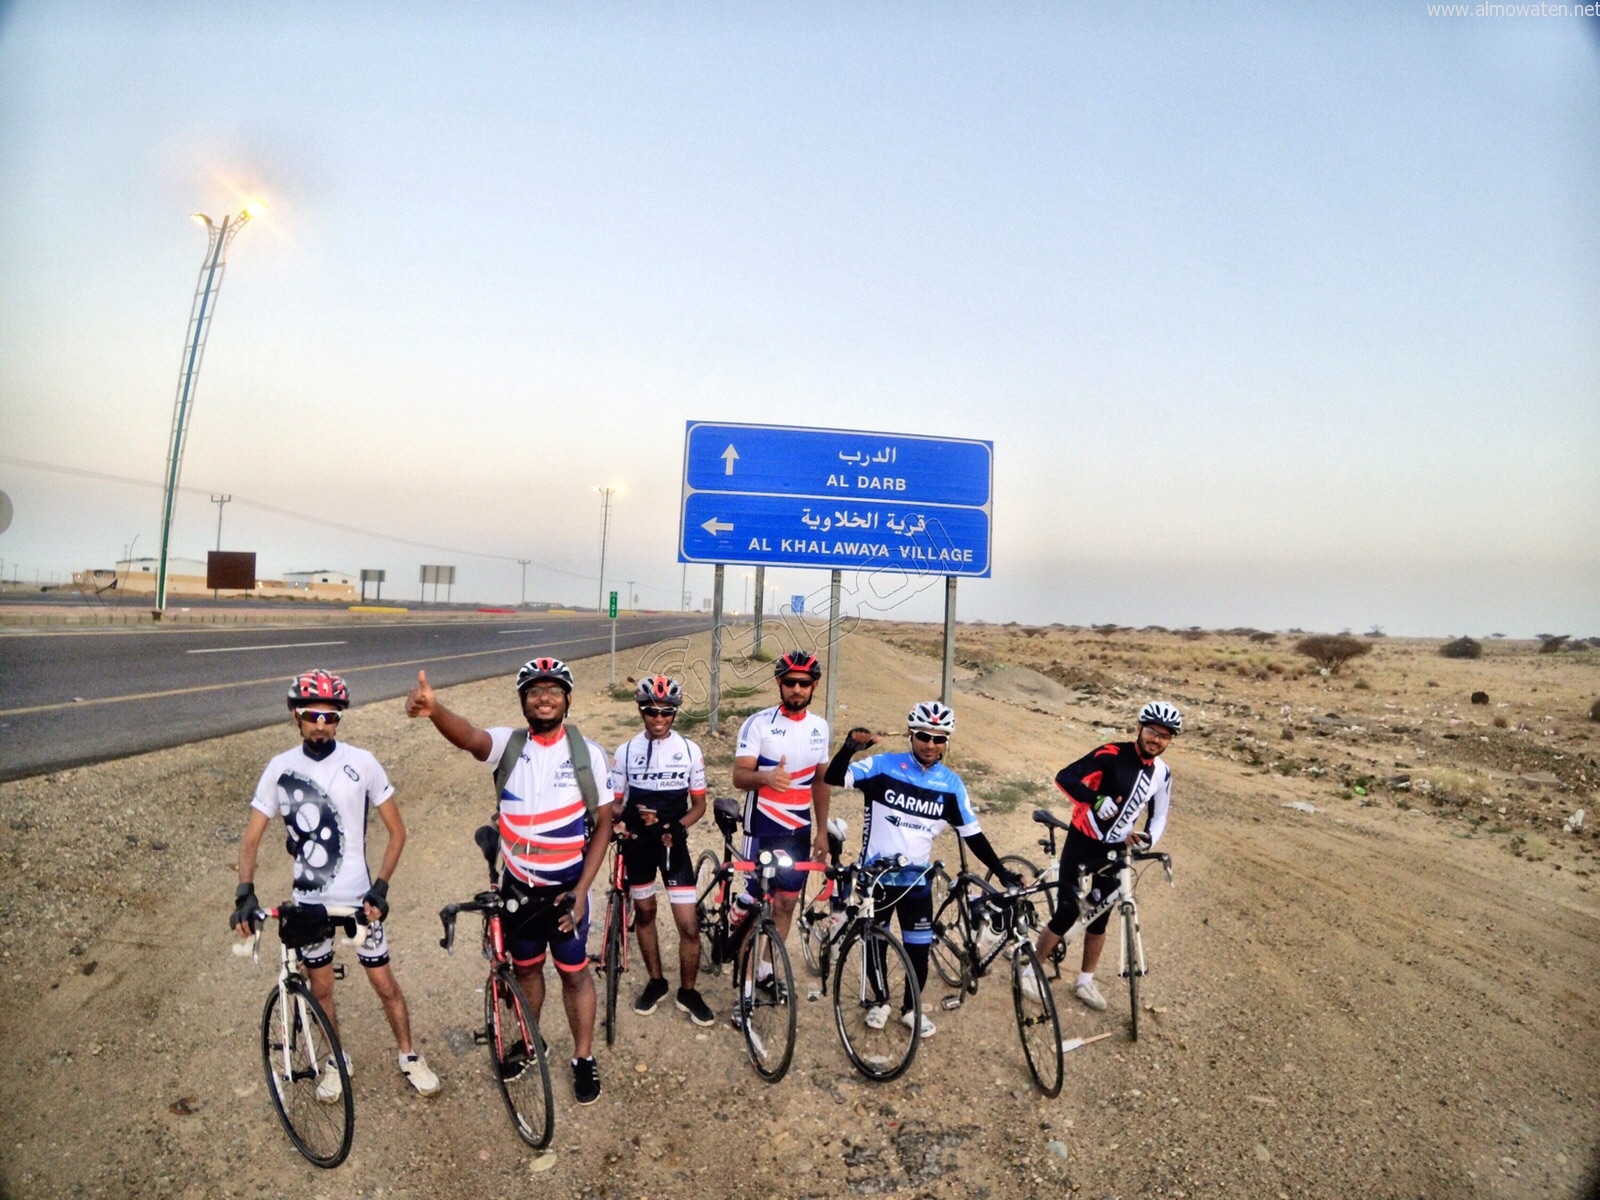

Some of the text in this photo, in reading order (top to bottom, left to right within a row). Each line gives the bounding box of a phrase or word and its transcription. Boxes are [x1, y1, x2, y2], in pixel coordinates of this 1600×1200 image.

[838, 446, 897, 467] الدرب
[826, 474, 906, 491] AL DARB
[801, 507, 926, 537] قرية الخلاوية
[748, 537, 974, 562] AL KHALAWAYA VILLAGE
[771, 728, 786, 737] sky
[630, 771, 686, 781] TREK
[884, 788, 945, 817] GARMIN
